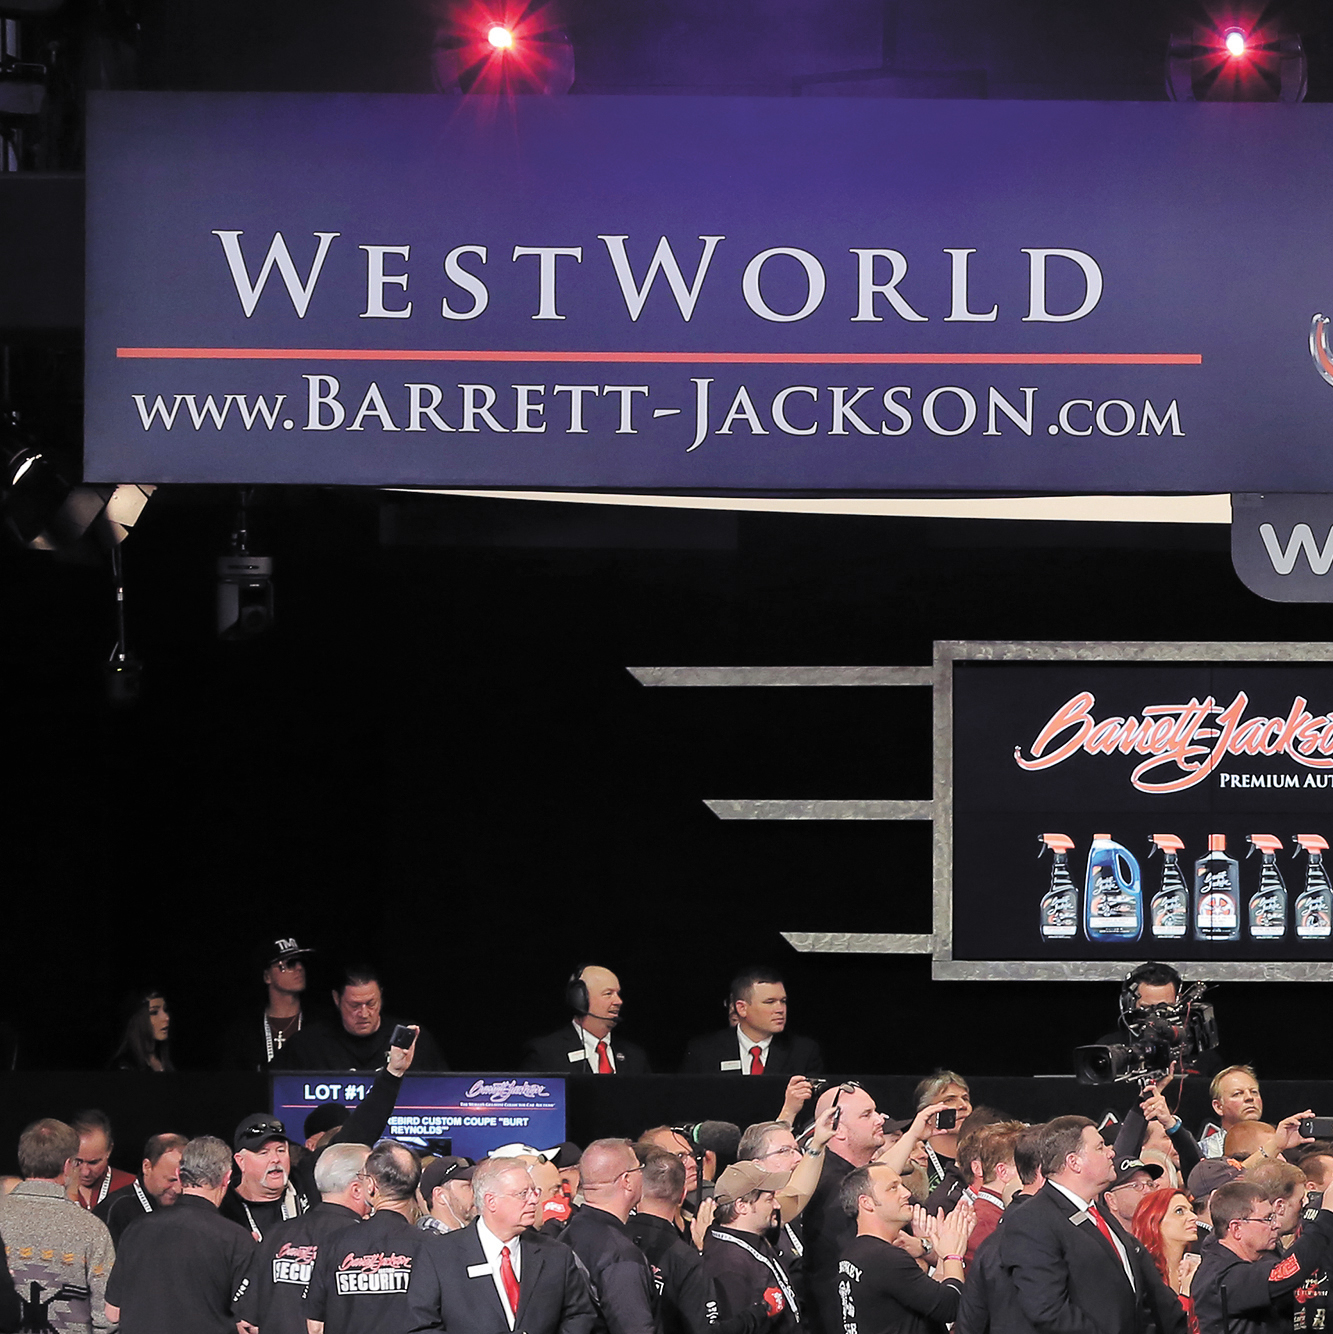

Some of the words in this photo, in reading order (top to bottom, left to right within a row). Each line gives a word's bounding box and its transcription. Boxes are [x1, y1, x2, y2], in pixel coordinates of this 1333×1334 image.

[1219, 772, 1301, 790] PREMIUM
[303, 1083, 342, 1101] LOT
[344, 1083, 373, 1101] #1
[387, 1116, 420, 1126] EBIRD
[422, 1116, 462, 1127] CUSTOM
[464, 1117, 497, 1127] COUPE
